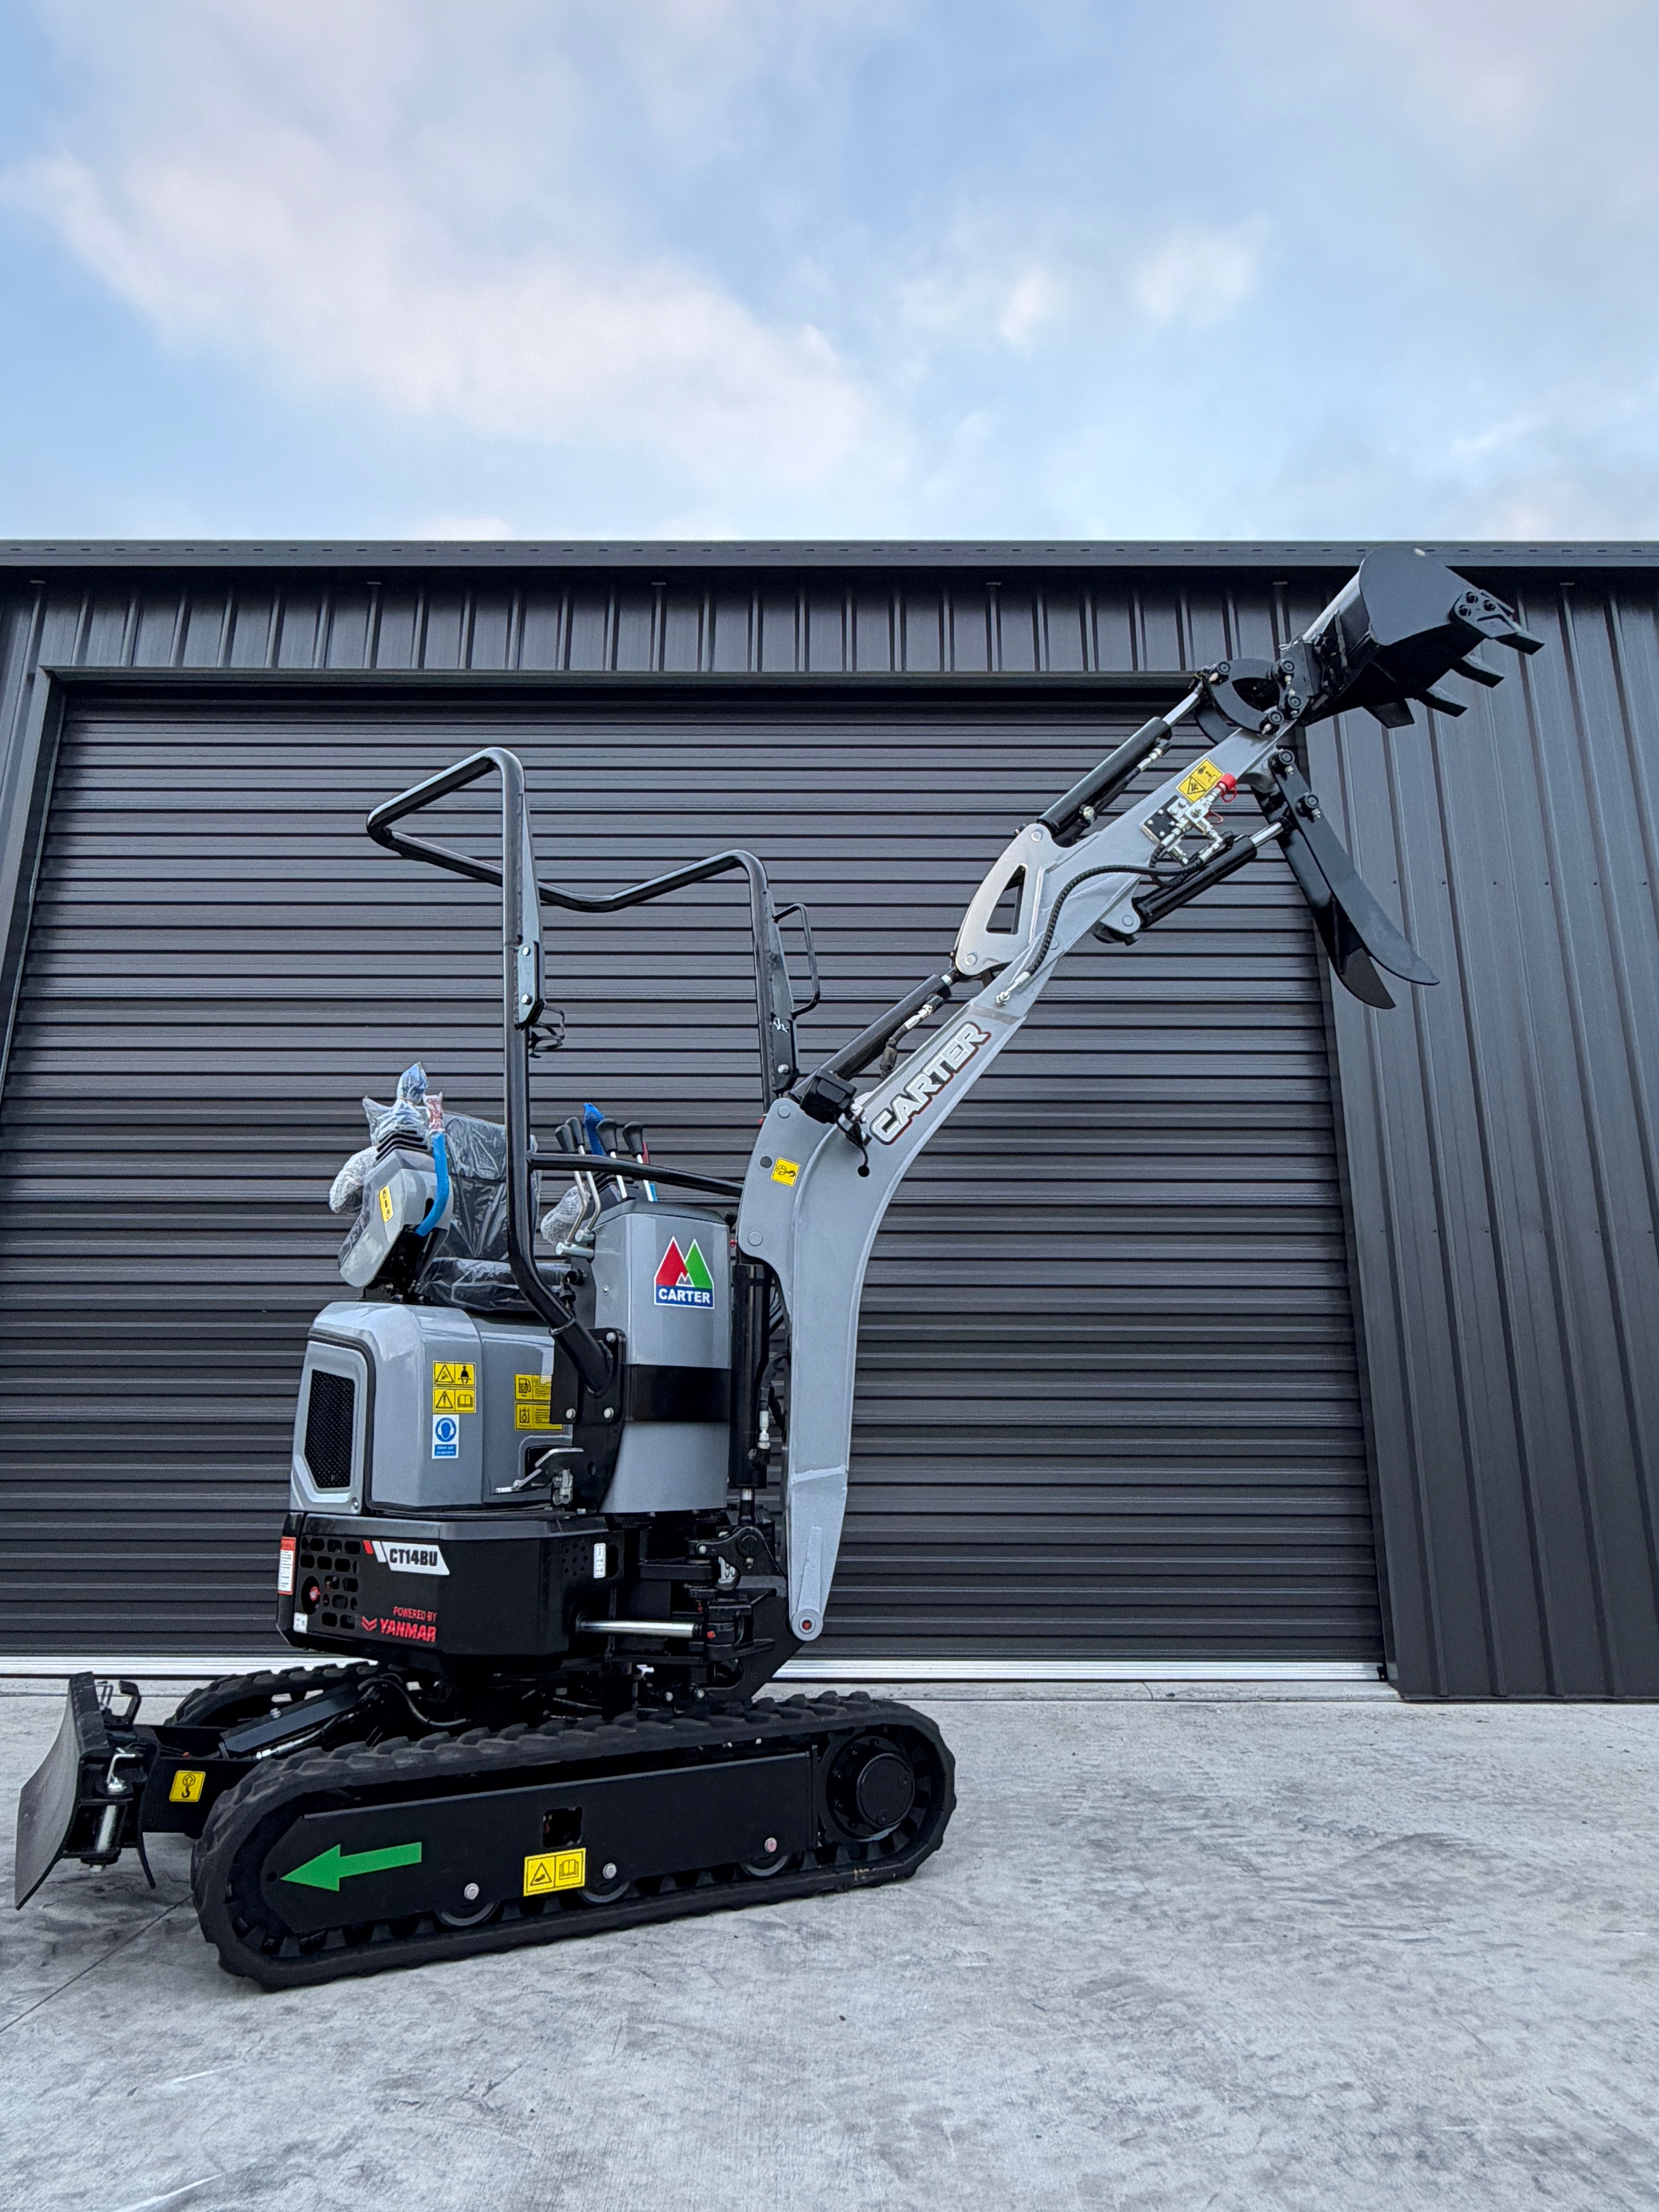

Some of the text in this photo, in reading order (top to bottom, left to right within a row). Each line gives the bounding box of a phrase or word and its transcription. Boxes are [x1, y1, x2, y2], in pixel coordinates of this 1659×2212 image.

[870, 1022, 991, 1144] CARTER
[658, 1288, 710, 1303] CARTER
[389, 1548, 438, 1566] CT14BU
[393, 1606, 438, 1622] POWERED BY
[380, 1618, 436, 1642] YANMAR
